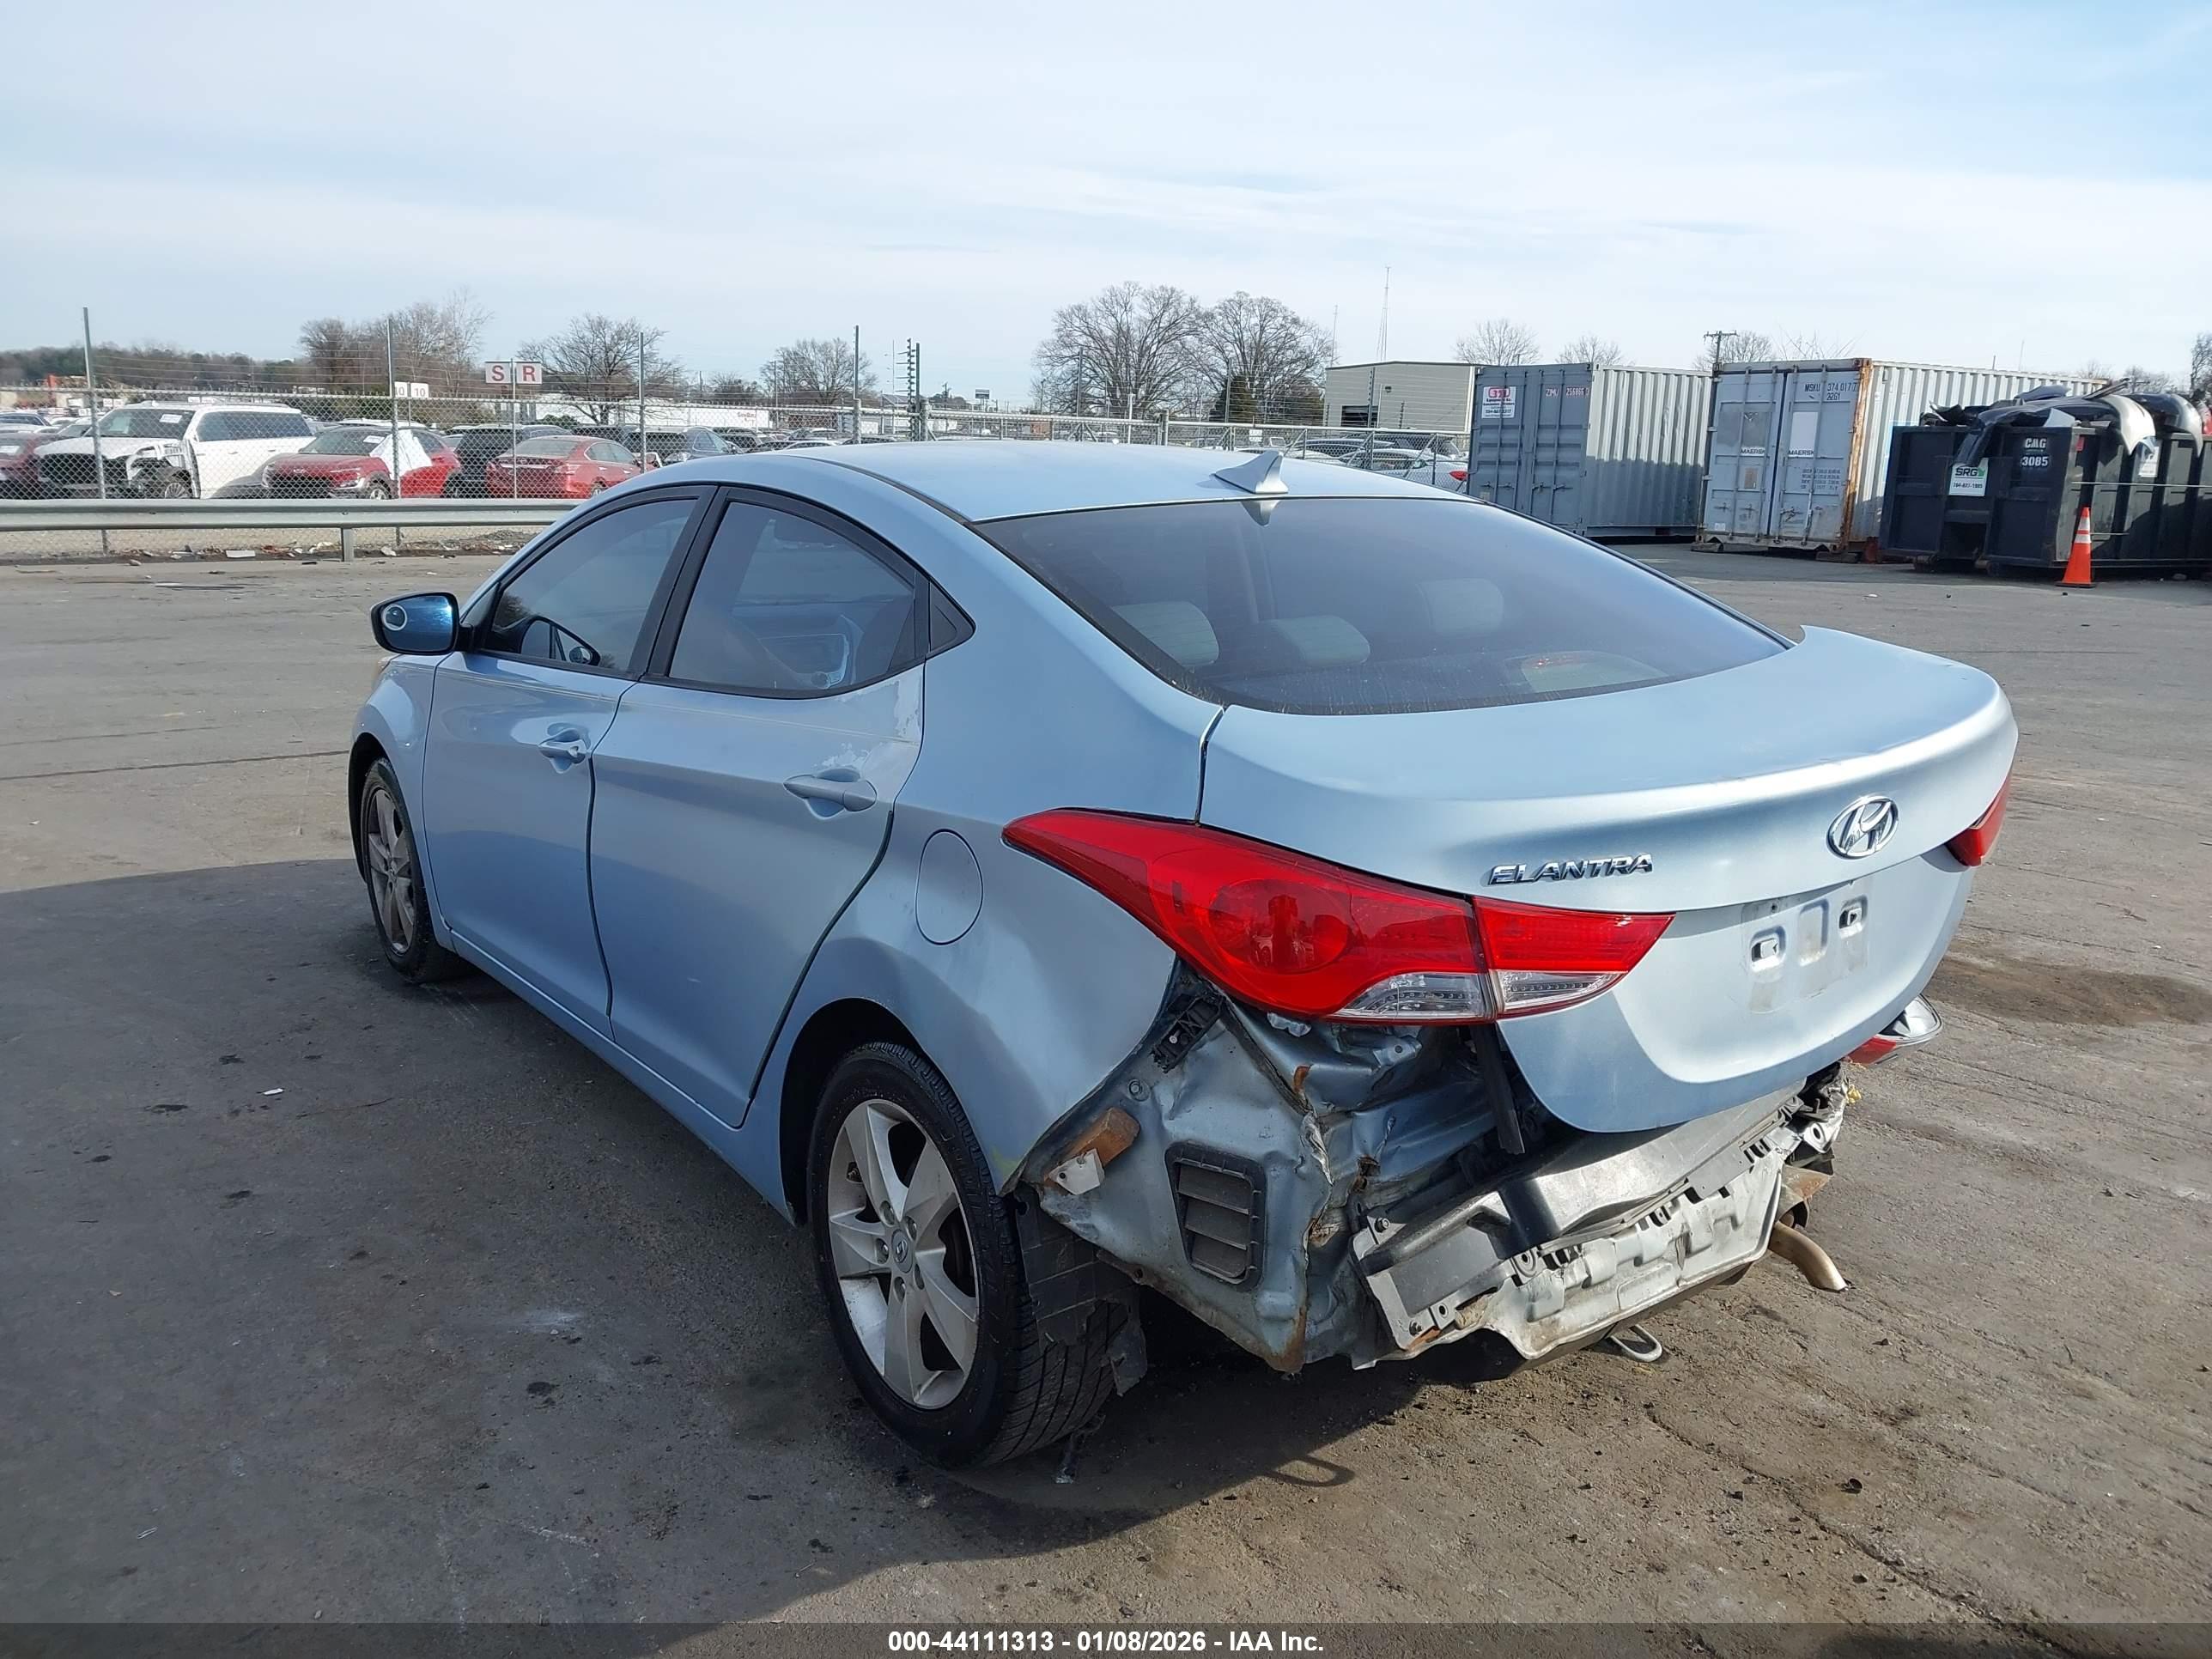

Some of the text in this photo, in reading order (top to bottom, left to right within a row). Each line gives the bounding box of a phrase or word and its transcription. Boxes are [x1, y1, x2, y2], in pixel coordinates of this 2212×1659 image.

[492, 365, 505, 381] S
[522, 365, 536, 382] R
[414, 387, 426, 397] 10
[2021, 456, 2048, 466] 3085
[1486, 853, 1653, 885] ELANTRA
